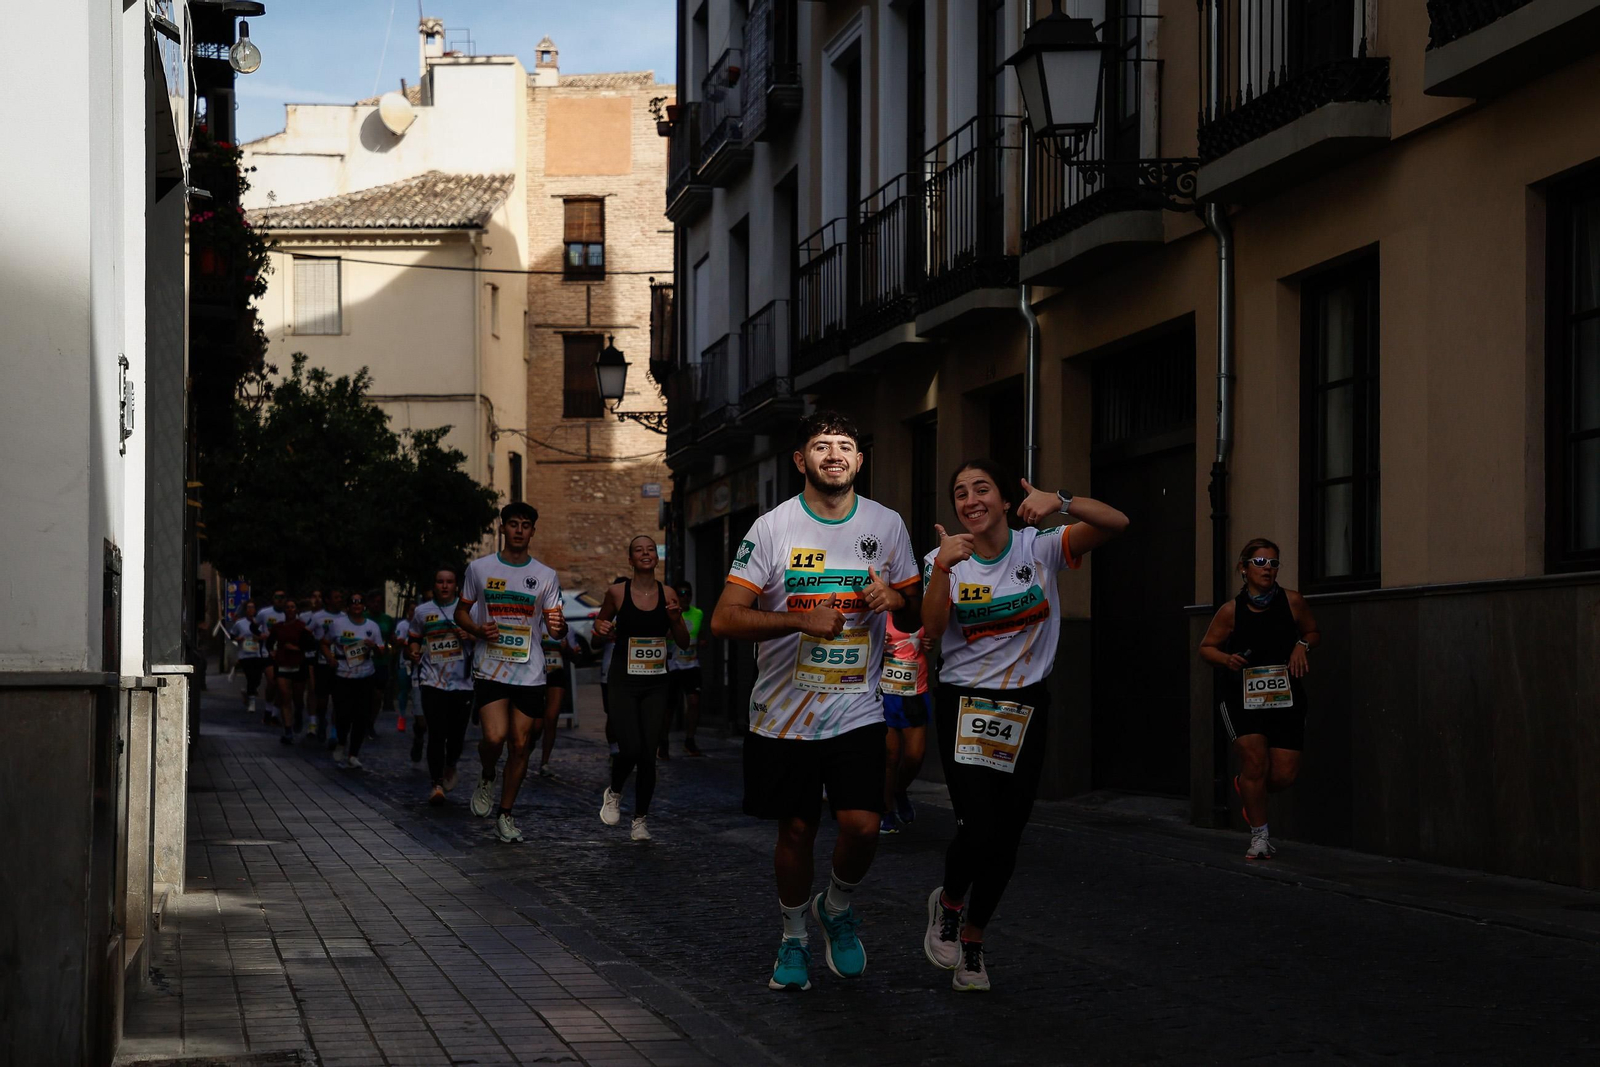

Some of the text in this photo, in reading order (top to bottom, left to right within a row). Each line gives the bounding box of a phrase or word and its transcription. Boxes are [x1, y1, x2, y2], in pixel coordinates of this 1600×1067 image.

[792, 553, 824, 568] 11ª
[787, 576, 874, 587] CARRERA
[960, 586, 990, 601] 11ª
[958, 592, 1037, 619] CARRERA
[432, 641, 458, 650] 1442
[636, 649, 661, 658] 890
[811, 646, 859, 664] 955
[886, 669, 911, 680] 308
[1248, 679, 1286, 691] 1082
[972, 718, 1012, 740] 954
